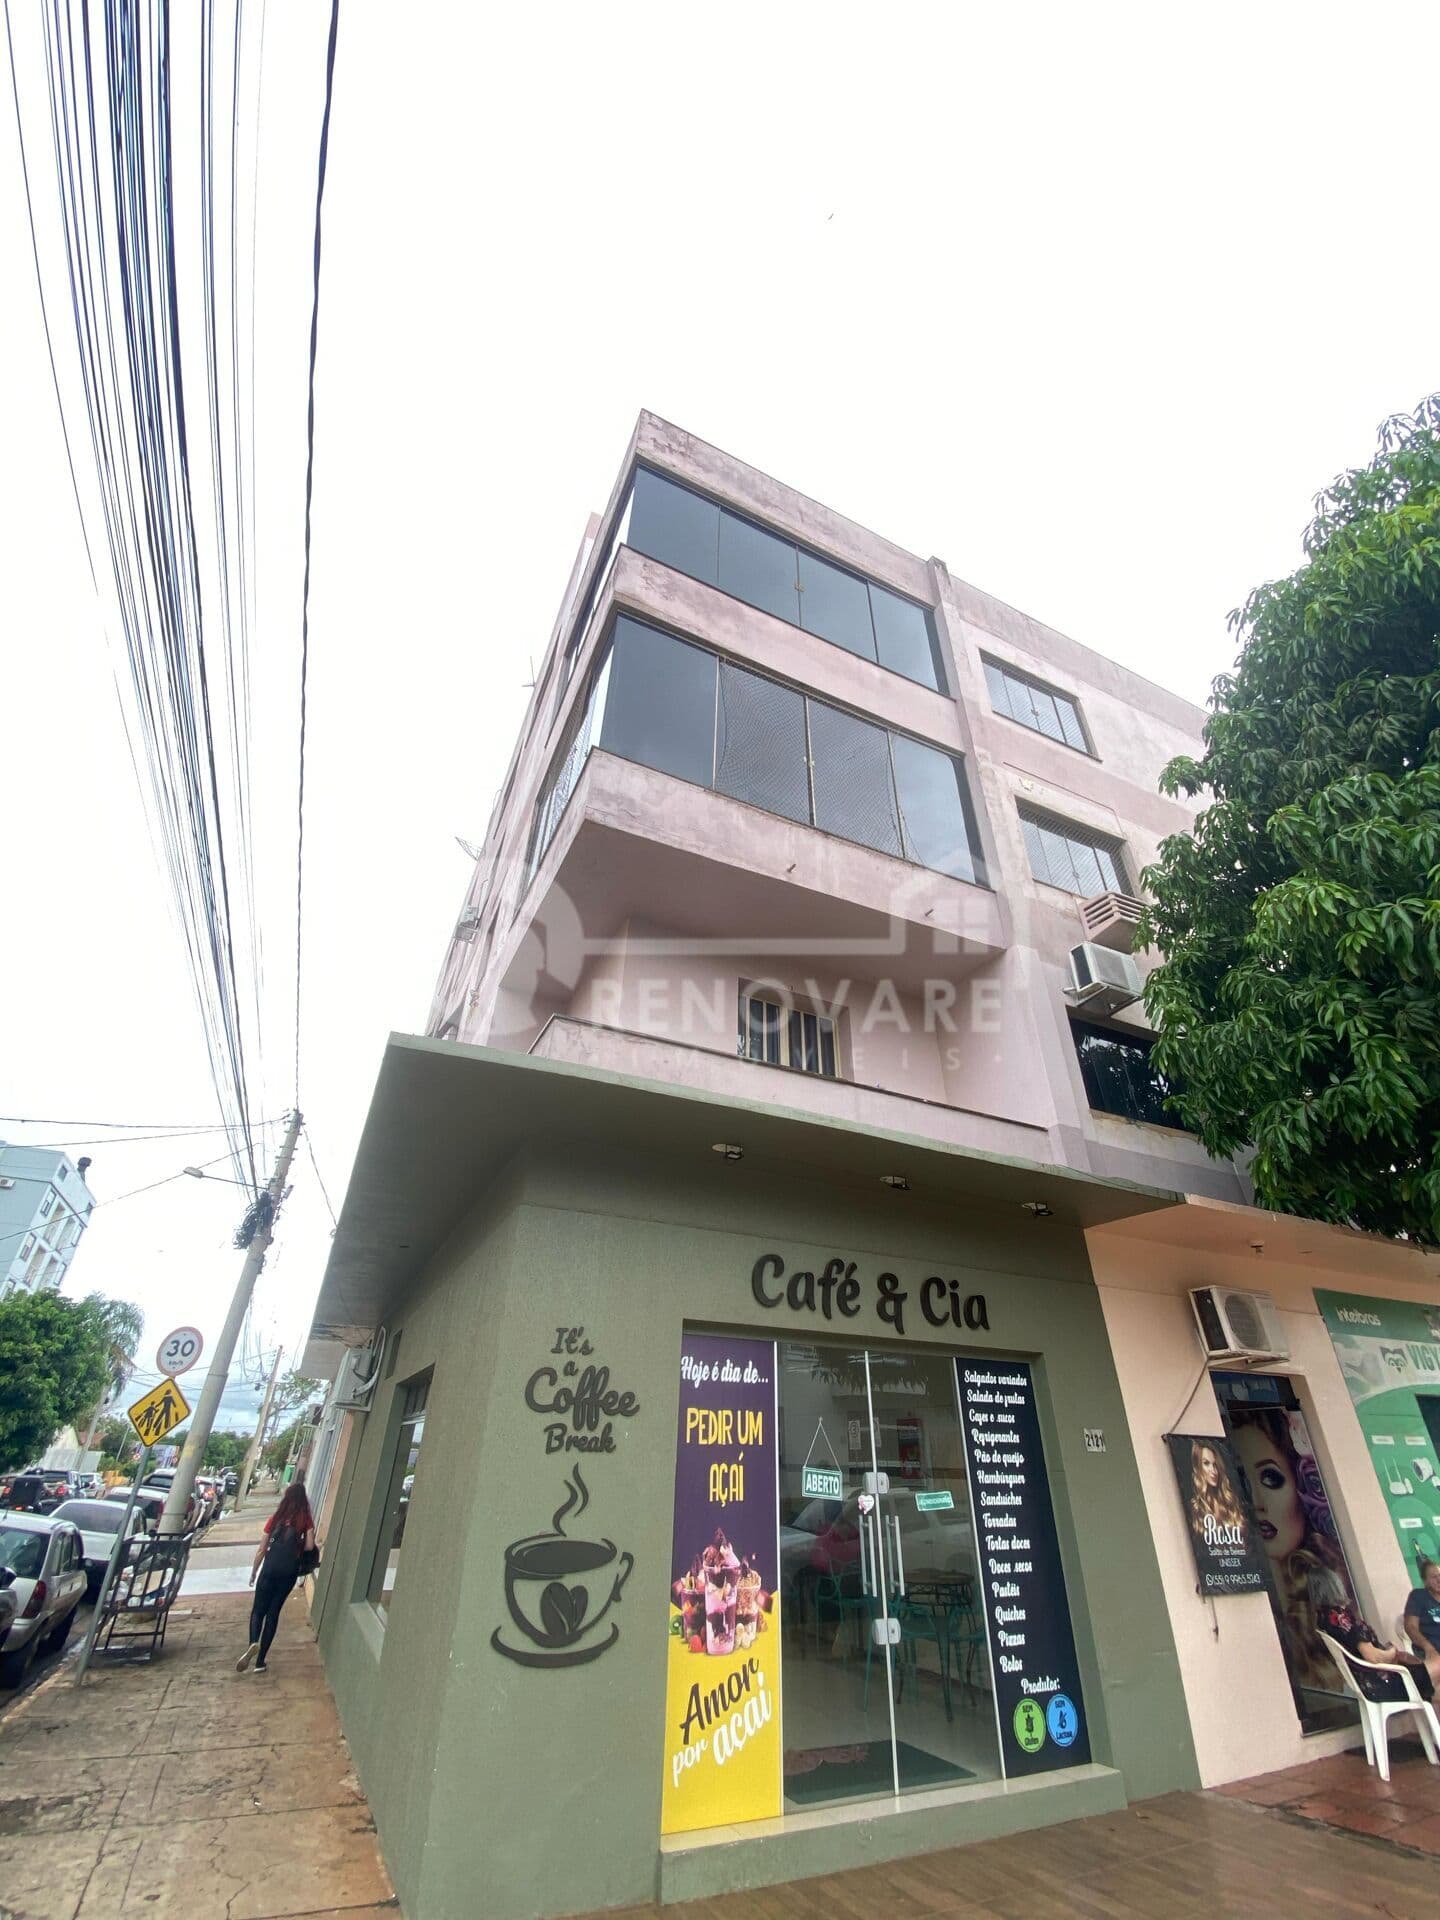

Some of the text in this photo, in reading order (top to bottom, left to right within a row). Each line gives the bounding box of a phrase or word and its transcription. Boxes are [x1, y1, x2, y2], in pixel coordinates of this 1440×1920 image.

[752, 1254, 990, 1335] Café & Cia
[166, 1339, 195, 1357] 30
[551, 1327, 594, 1355] It's
[1405, 1343, 1440, 1371] VIGY
[563, 1361, 578, 1377] a
[681, 1356, 710, 1388] Hoje
[712, 1361, 720, 1382] é
[720, 1358, 742, 1383] dia
[964, 1369, 1027, 1387] Salgados variados
[525, 1365, 640, 1431] Coffee
[967, 1389, 994, 1403] Salada
[994, 1391, 1004, 1404] de
[686, 1407, 763, 1446] PEDIR UM
[996, 1413, 1015, 1424] sucos
[544, 1423, 616, 1454] Break
[971, 1428, 1020, 1447] Refrigerantes
[974, 1449, 1025, 1468] Pão de queijo
[709, 1451, 744, 1507] AÇAÍ
[806, 1473, 840, 1495] ABERTO
[982, 1512, 1017, 1528] Torradas
[1203, 1513, 1244, 1546] Rosa
[985, 1534, 1031, 1551] Tortas doces
[988, 1558, 1033, 1575] Doces secos
[995, 1605, 1026, 1625] Quiches
[998, 1630, 1026, 1647] Pizzas
[999, 1655, 1023, 1673] Bolos
[1021, 1675, 1060, 1695] Produtos:
[680, 1657, 760, 1745] Amor
[672, 1738, 708, 1788] por
